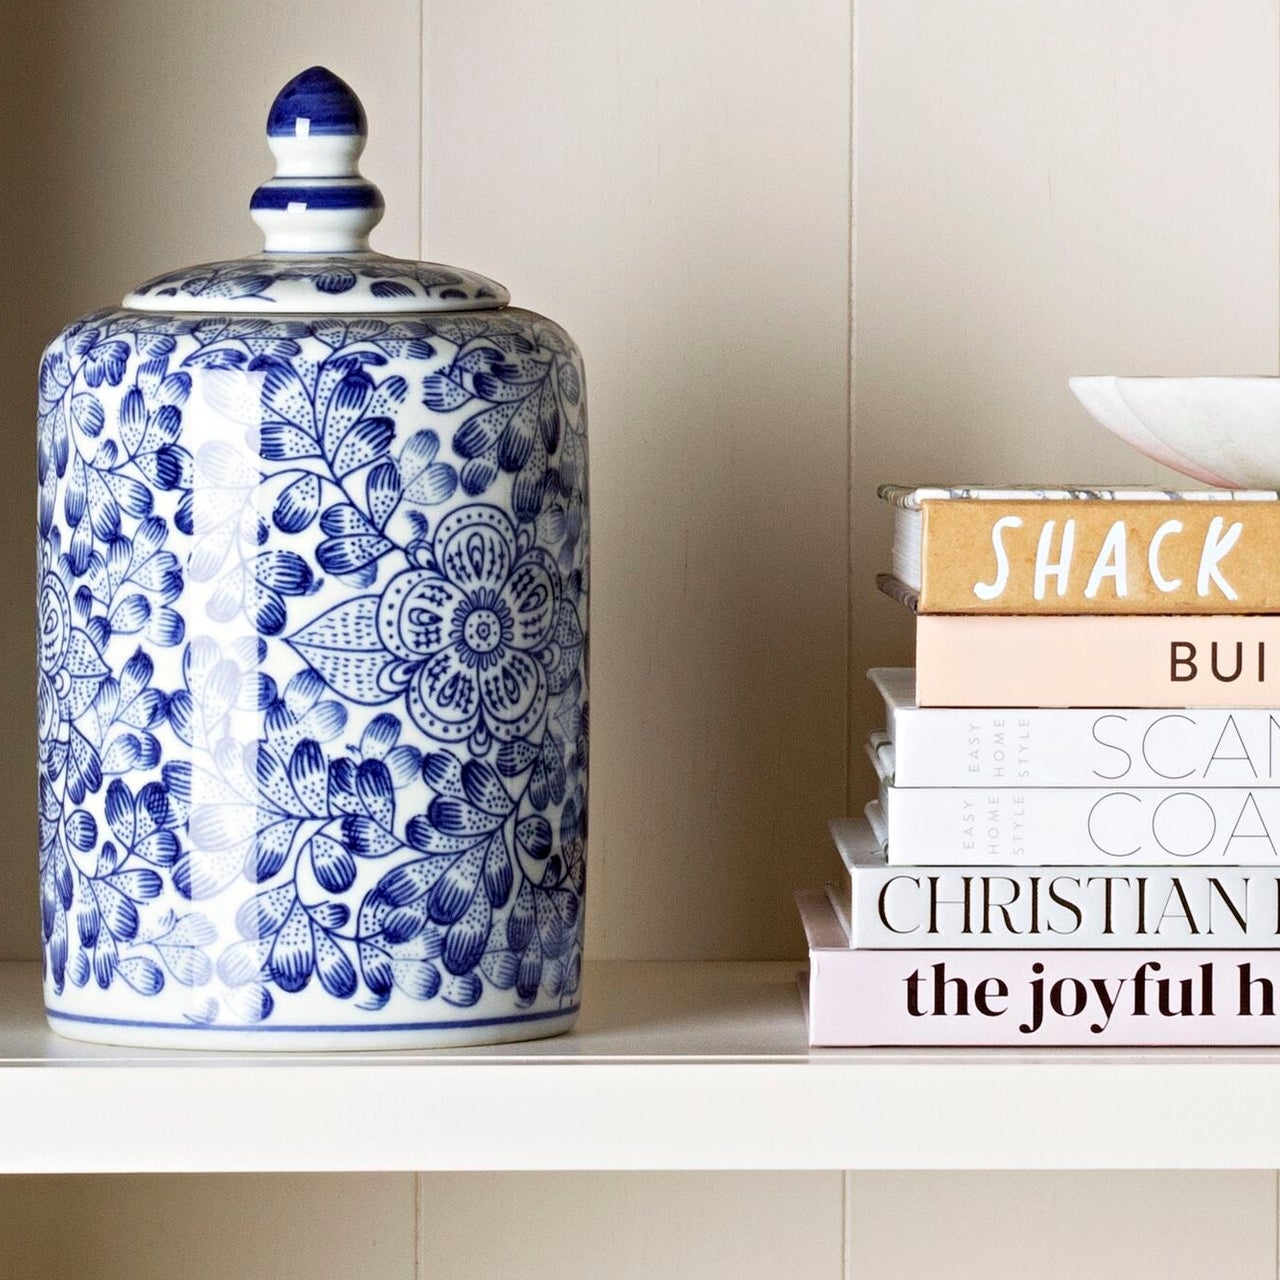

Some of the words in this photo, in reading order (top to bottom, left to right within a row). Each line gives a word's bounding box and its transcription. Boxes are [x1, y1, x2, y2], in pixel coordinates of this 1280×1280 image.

[973, 515, 1243, 601] SHACK
[968, 722, 980, 773] EASY
[993, 719, 1005, 777] HOME
[1018, 719, 1030, 778] STYLE
[962, 800, 975, 850] EASY
[987, 796, 1000, 855] HOME
[1012, 796, 1025, 856] STYLE
[877, 875, 1251, 936] CHRISTIAN
[902, 961, 1009, 1017] the
[1019, 961, 1216, 1034] joyful
